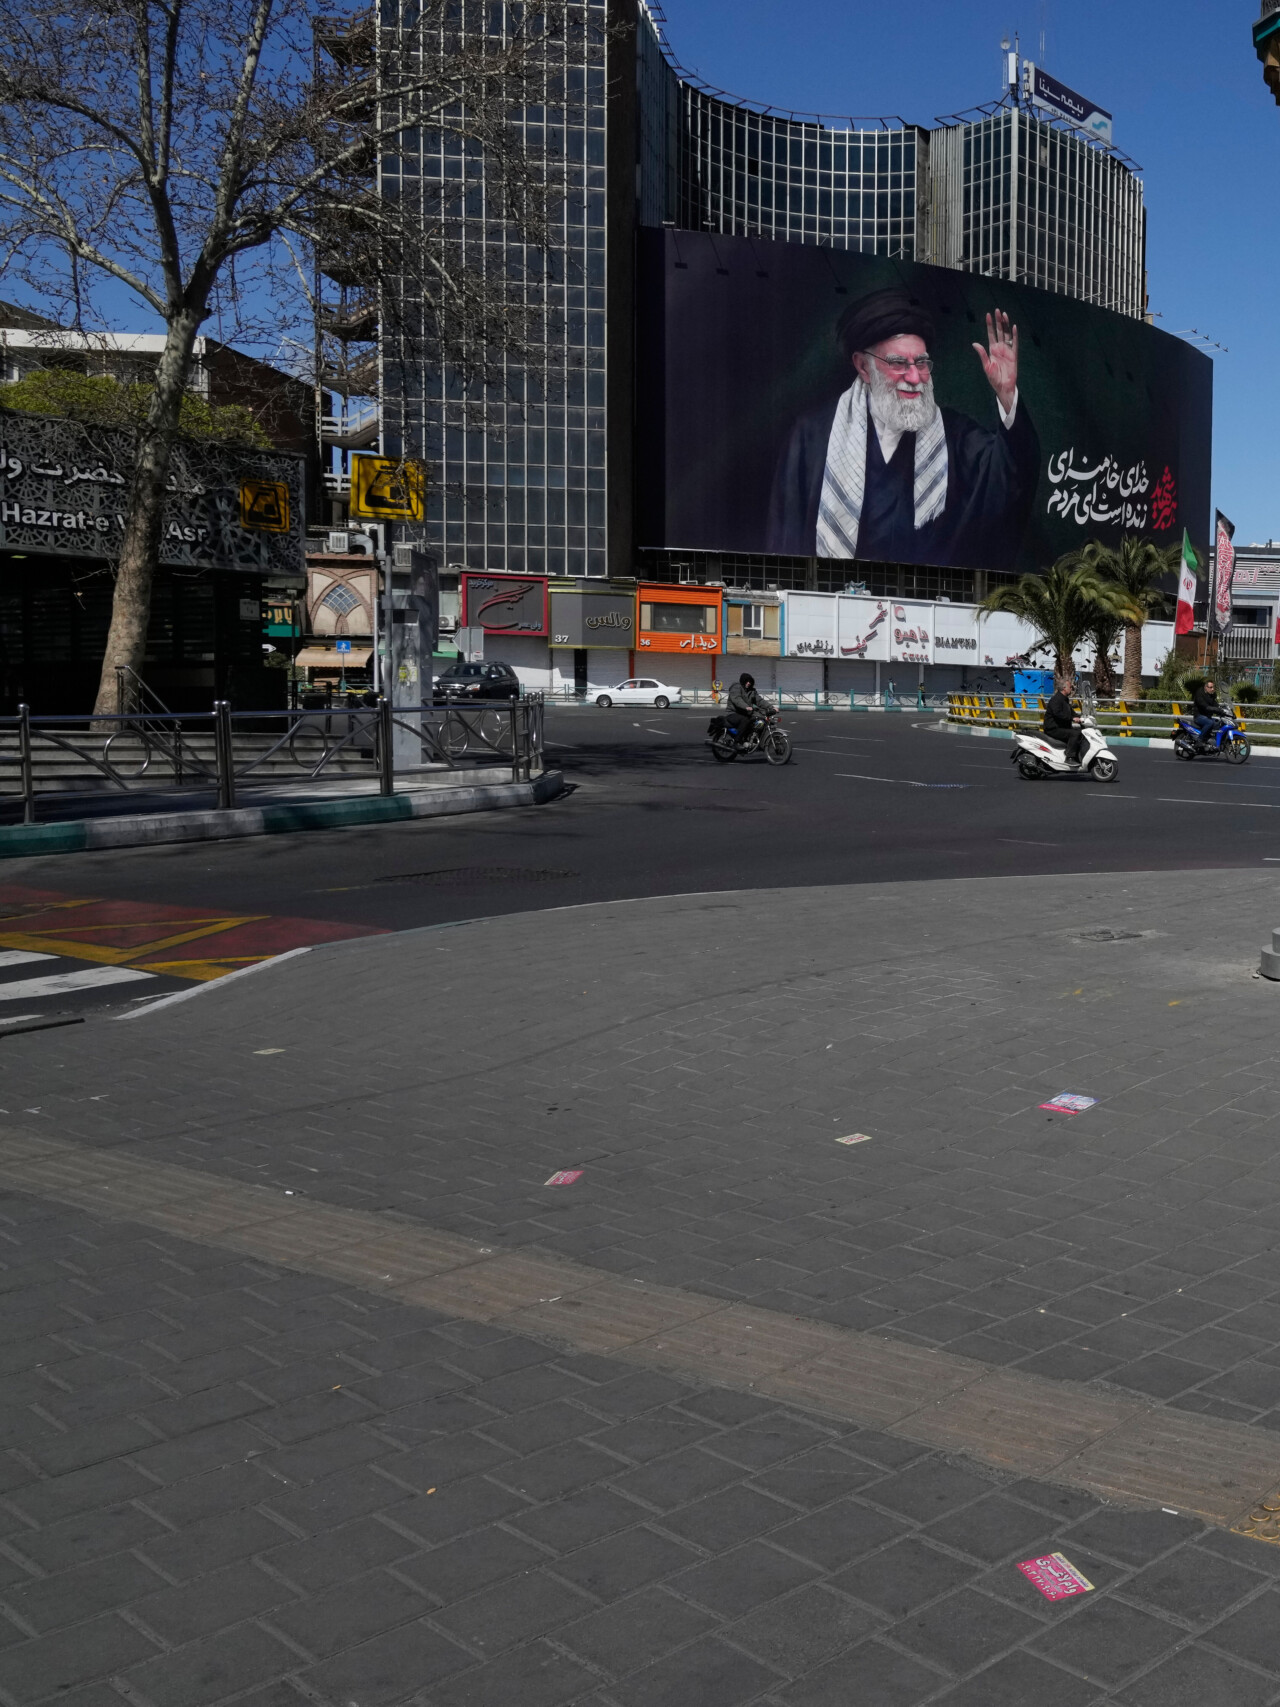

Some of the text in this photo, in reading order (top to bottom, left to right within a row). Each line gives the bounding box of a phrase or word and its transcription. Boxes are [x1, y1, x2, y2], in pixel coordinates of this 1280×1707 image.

[1039, 77, 1060, 101] سینا
[1061, 94, 1084, 117] بیمه
[31, 457, 126, 486] حضرت
[1047, 484, 1081, 519] مردم
[2, 502, 110, 532] Hazrat-e
[1125, 503, 1148, 529] زنده
[166, 521, 207, 543] Asr
[585, 611, 632, 631] والس
[555, 634, 570, 644] 37
[680, 634, 717, 650] دیدار
